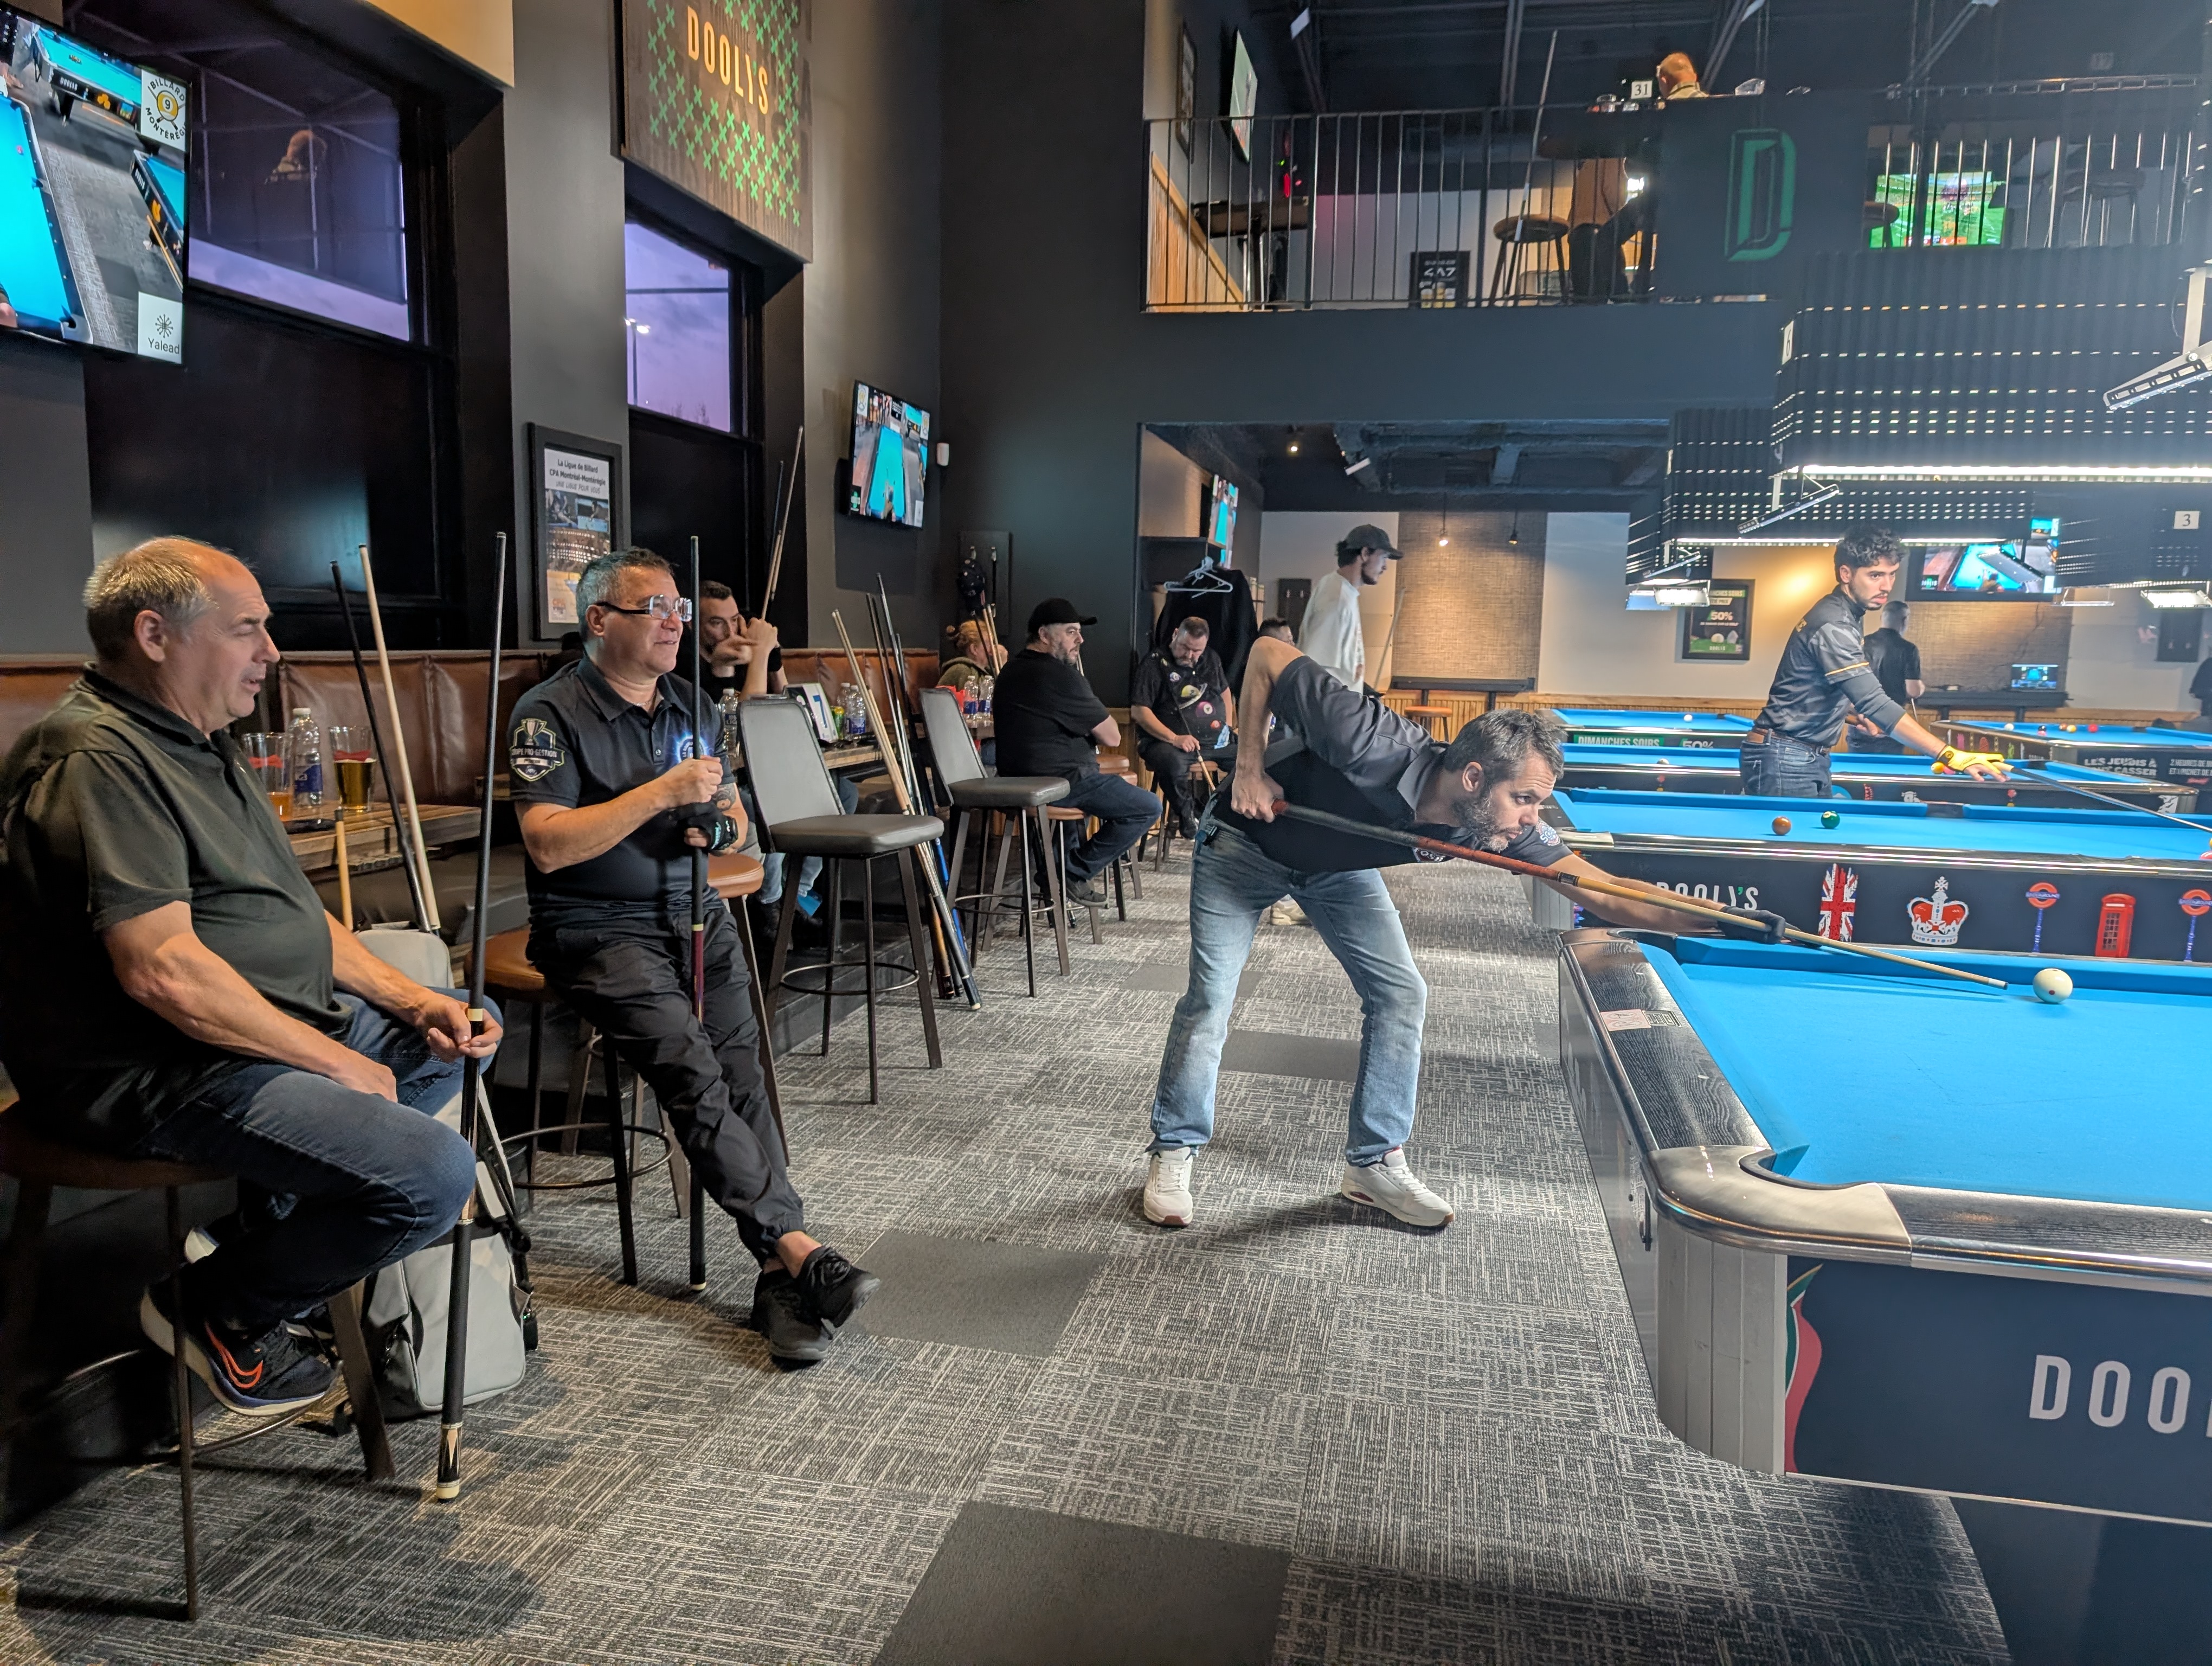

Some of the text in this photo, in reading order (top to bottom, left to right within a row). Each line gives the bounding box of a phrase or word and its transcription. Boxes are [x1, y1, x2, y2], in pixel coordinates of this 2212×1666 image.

[687, 5, 768, 114] DOOLY'S
[150, 78, 185, 101] BILLARD
[1635, 84, 1648, 96] 31
[165, 99, 171, 110] 9
[145, 107, 186, 140] MONTÉRÉGI
[148, 337, 180, 354] Yalead
[1786, 329, 1791, 357] 6
[2182, 514, 2191, 527] 3
[1711, 611, 1733, 620] 50%
[2084, 758, 2105, 766] LES
[2107, 758, 2147, 766] JEUDIS
[2029, 1355, 2212, 1438] DOO
